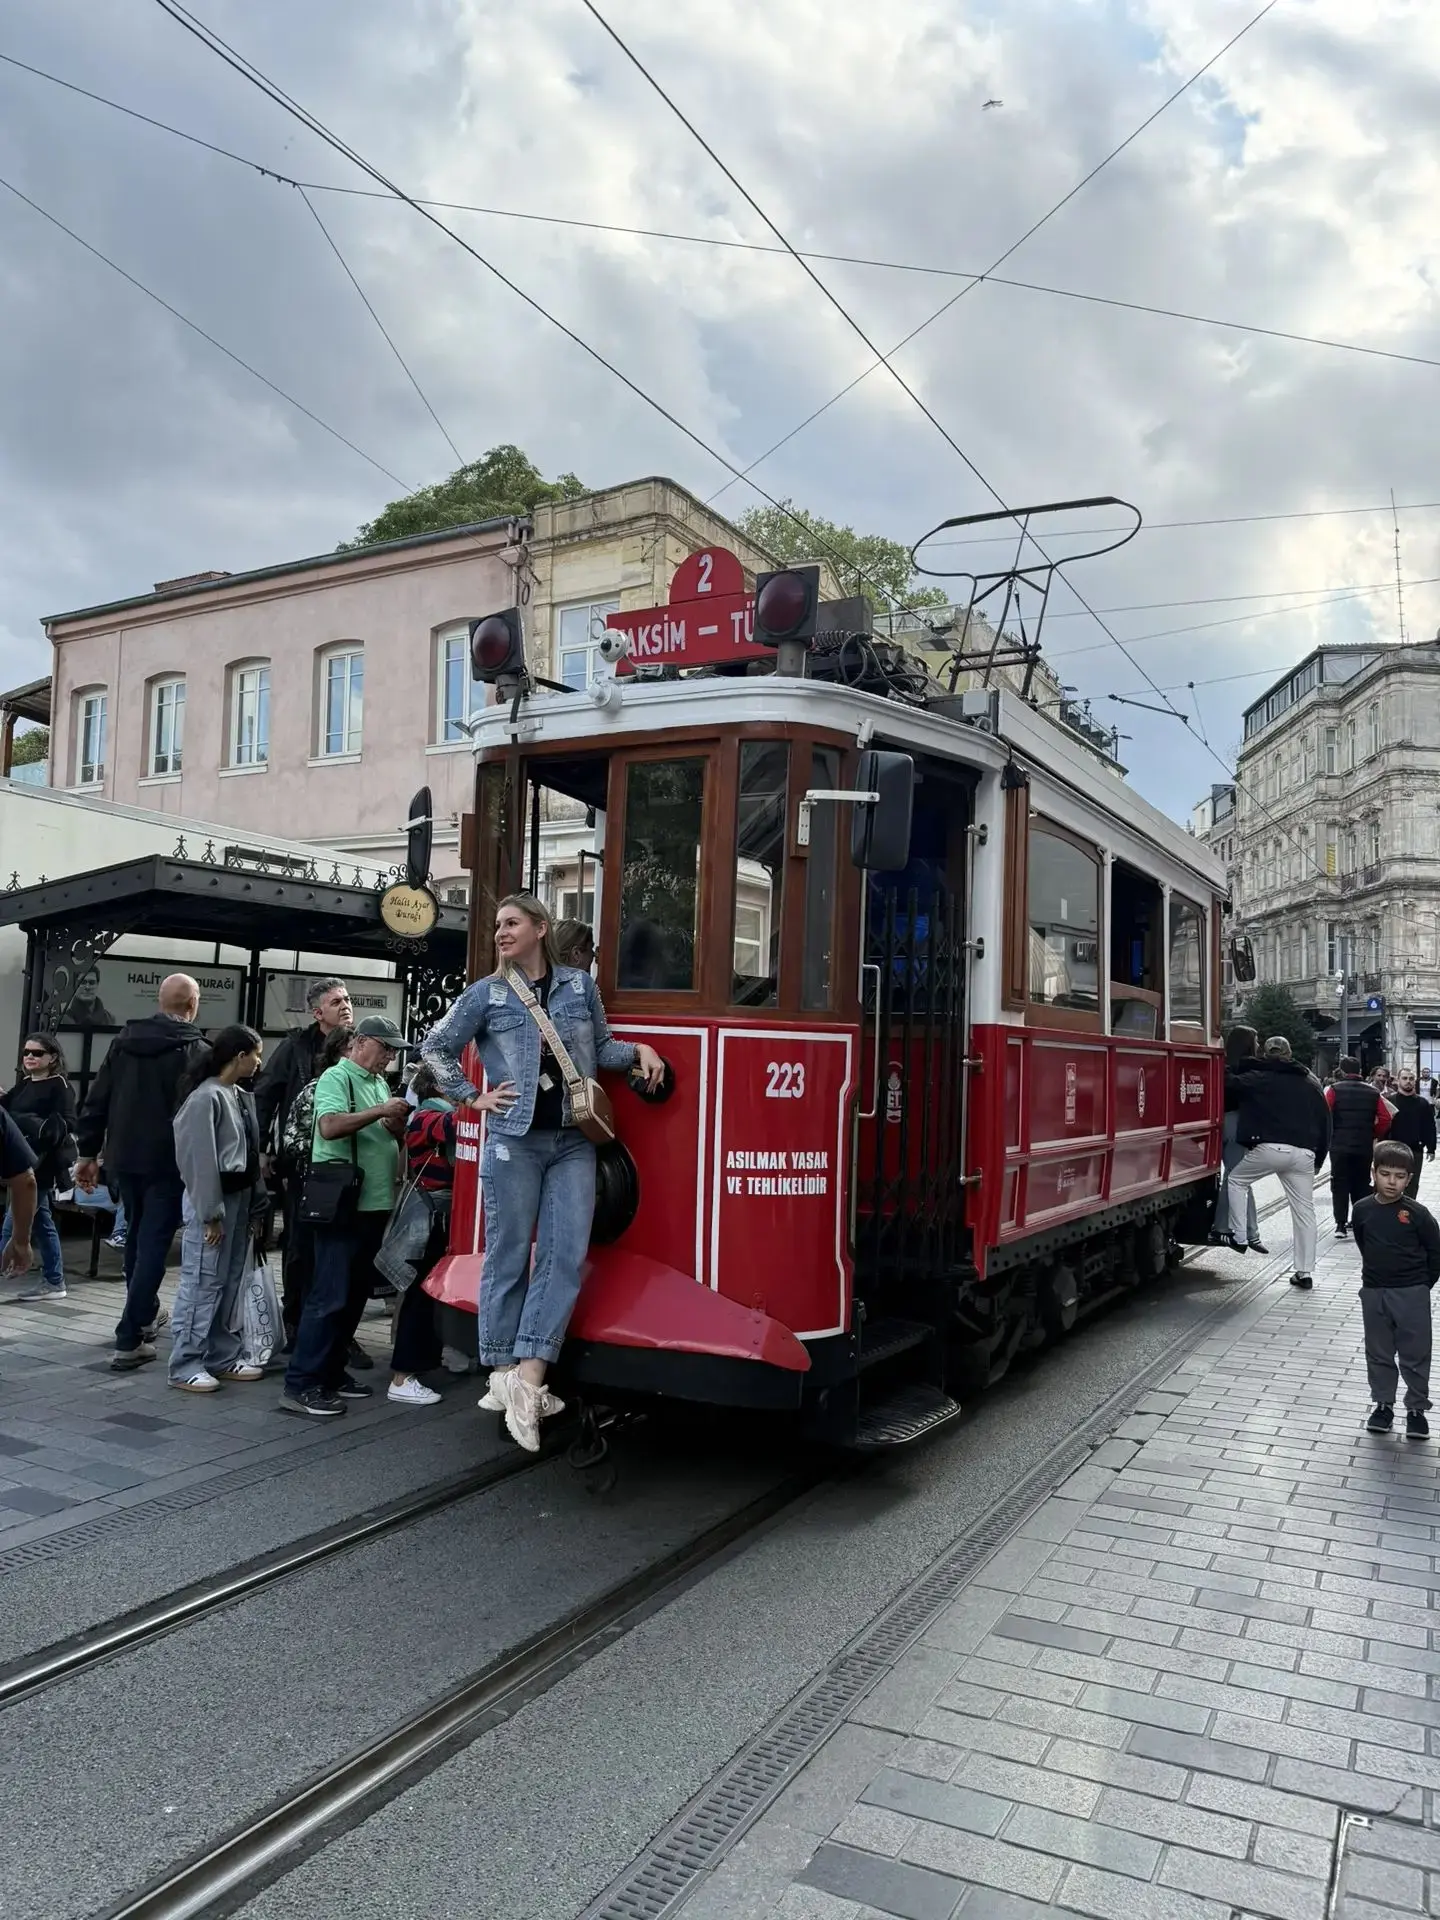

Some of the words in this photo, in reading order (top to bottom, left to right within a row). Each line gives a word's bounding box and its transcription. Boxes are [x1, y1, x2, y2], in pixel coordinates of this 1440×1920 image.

[697, 553, 713, 593] 2
[623, 613, 686, 657] AKSİM
[731, 601, 755, 643] TÜ
[127, 972, 161, 985] HALİT
[765, 1061, 805, 1098] 223
[726, 1150, 787, 1170] ASILMAK
[791, 1151, 828, 1170] YASAK
[726, 1176, 742, 1195] VE
[746, 1173, 827, 1195] TEHLİKELİDİR
